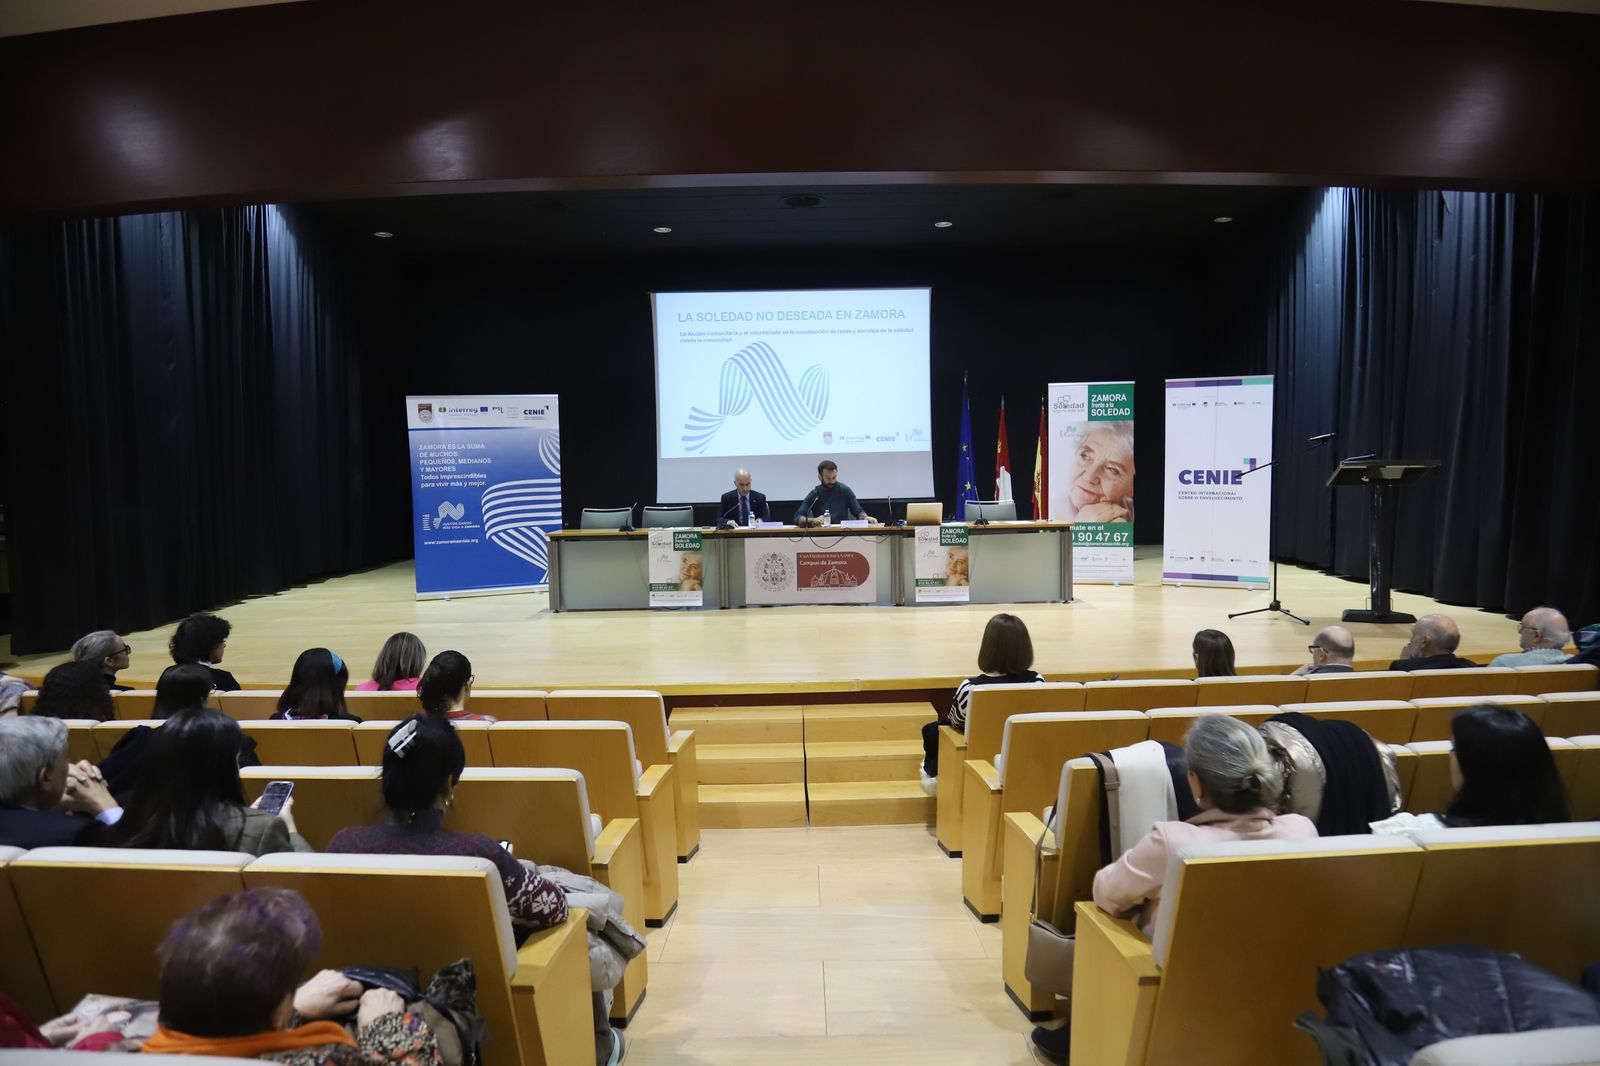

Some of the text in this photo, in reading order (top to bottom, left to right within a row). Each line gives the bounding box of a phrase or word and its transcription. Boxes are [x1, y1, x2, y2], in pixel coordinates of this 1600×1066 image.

[678, 309, 906, 322] LA SOLEDAD NO DESEADA EN ZAMORA
[1091, 393, 1127, 402] ZAMORA
[1053, 402, 1085, 410] Soledad
[1091, 408, 1130, 417] SOLEDAD
[1178, 470, 1243, 485] CENIE
[1078, 532, 1093, 542] 90
[1095, 532, 1111, 542] 47
[1113, 532, 1129, 542] 67
